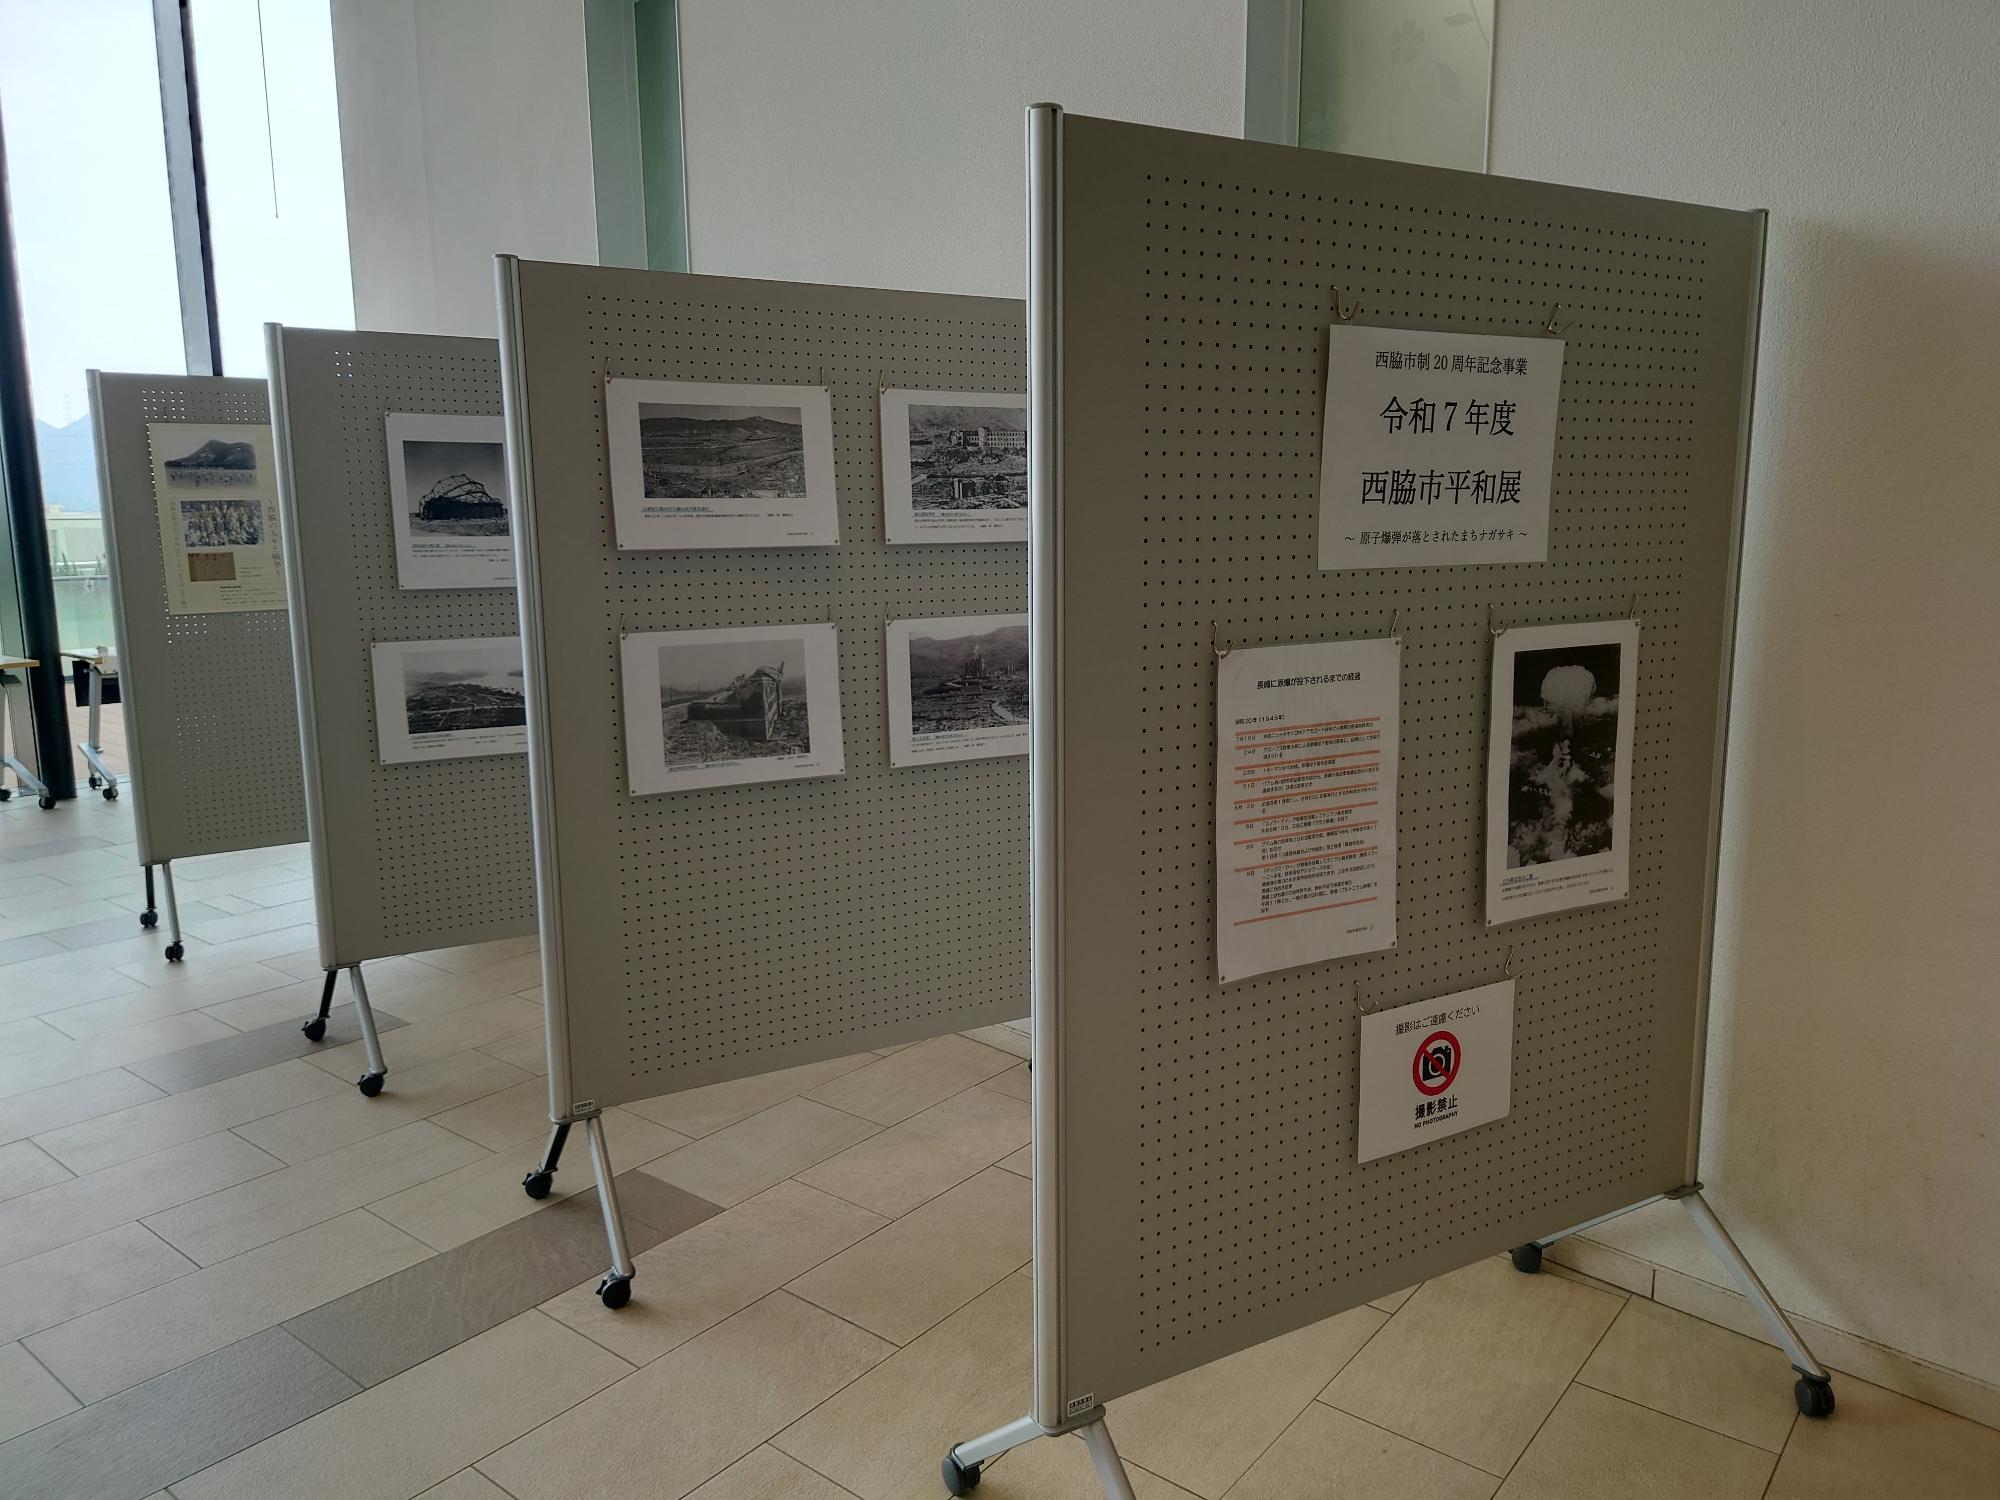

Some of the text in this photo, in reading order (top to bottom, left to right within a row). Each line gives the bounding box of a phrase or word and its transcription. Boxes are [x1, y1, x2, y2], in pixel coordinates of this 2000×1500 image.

[1379, 396, 1517, 436] 令和7年度
[1361, 469, 1522, 505] 西脇市平和展
[1395, 1004, 1480, 1036] 撮影はご遠慮ください
[1415, 1094, 1458, 1120] 撮影禁止
[1422, 1110, 1459, 1127] PHOTOGRAPHY
